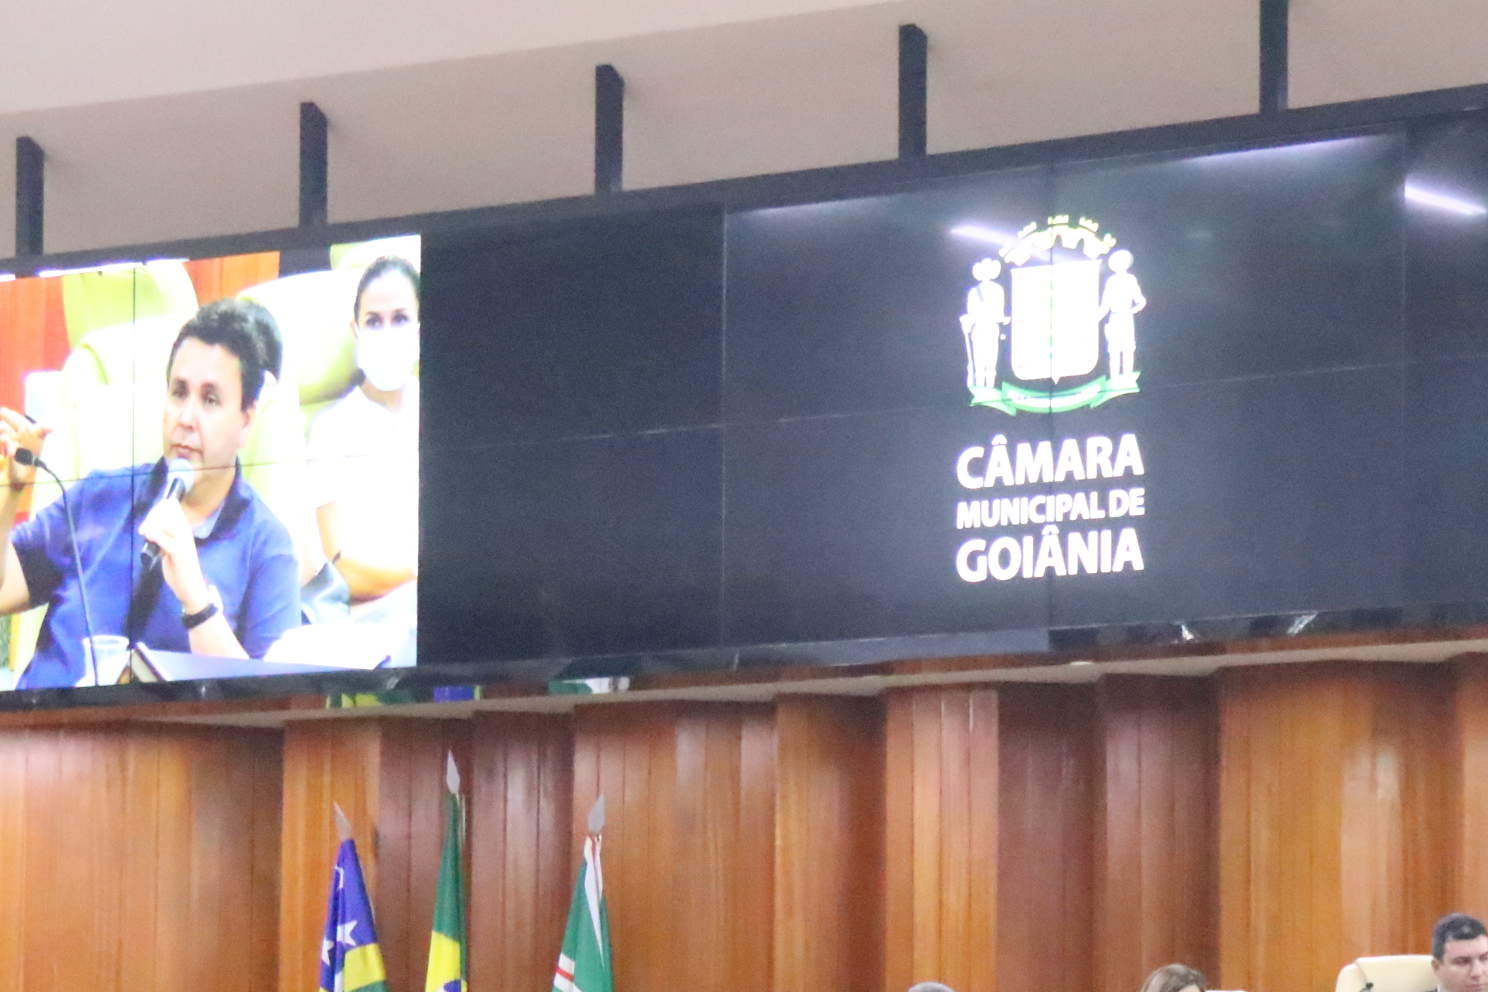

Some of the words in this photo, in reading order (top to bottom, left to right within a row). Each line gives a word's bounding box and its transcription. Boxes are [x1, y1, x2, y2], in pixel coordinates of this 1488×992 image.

[957, 433, 1145, 489] CÂMARA
[957, 491, 1106, 529] MUNICIPAL
[1109, 487, 1146, 518] DE
[956, 524, 1145, 582] GOIÂNIA
